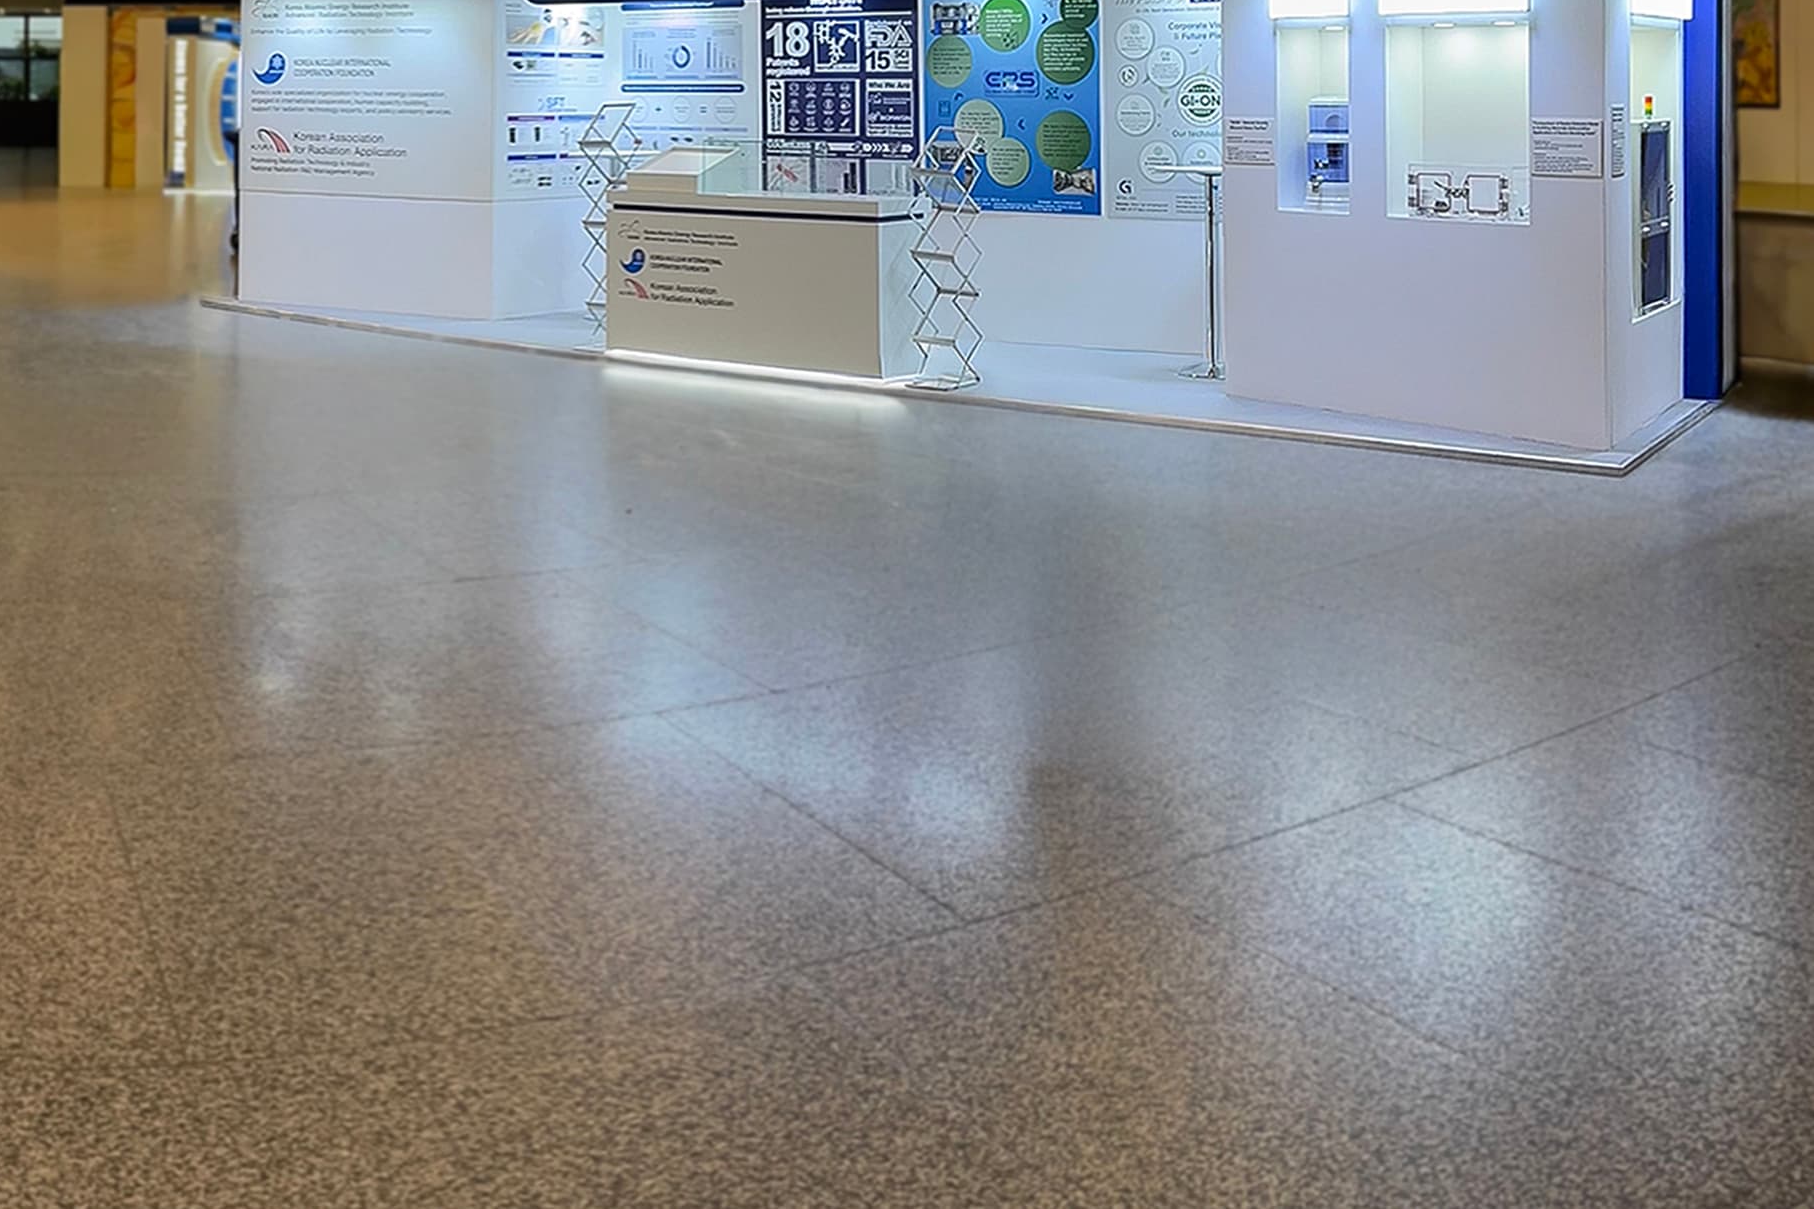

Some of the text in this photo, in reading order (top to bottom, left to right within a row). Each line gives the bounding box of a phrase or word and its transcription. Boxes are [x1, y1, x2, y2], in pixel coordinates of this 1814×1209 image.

[766, 21, 811, 58] 18
[866, 50, 891, 71] 15
[294, 132, 385, 143] Korean Association
[293, 146, 408, 158] for Radiation Application
[650, 283, 718, 295] Korean Association
[650, 293, 734, 307] for Radiation Application
